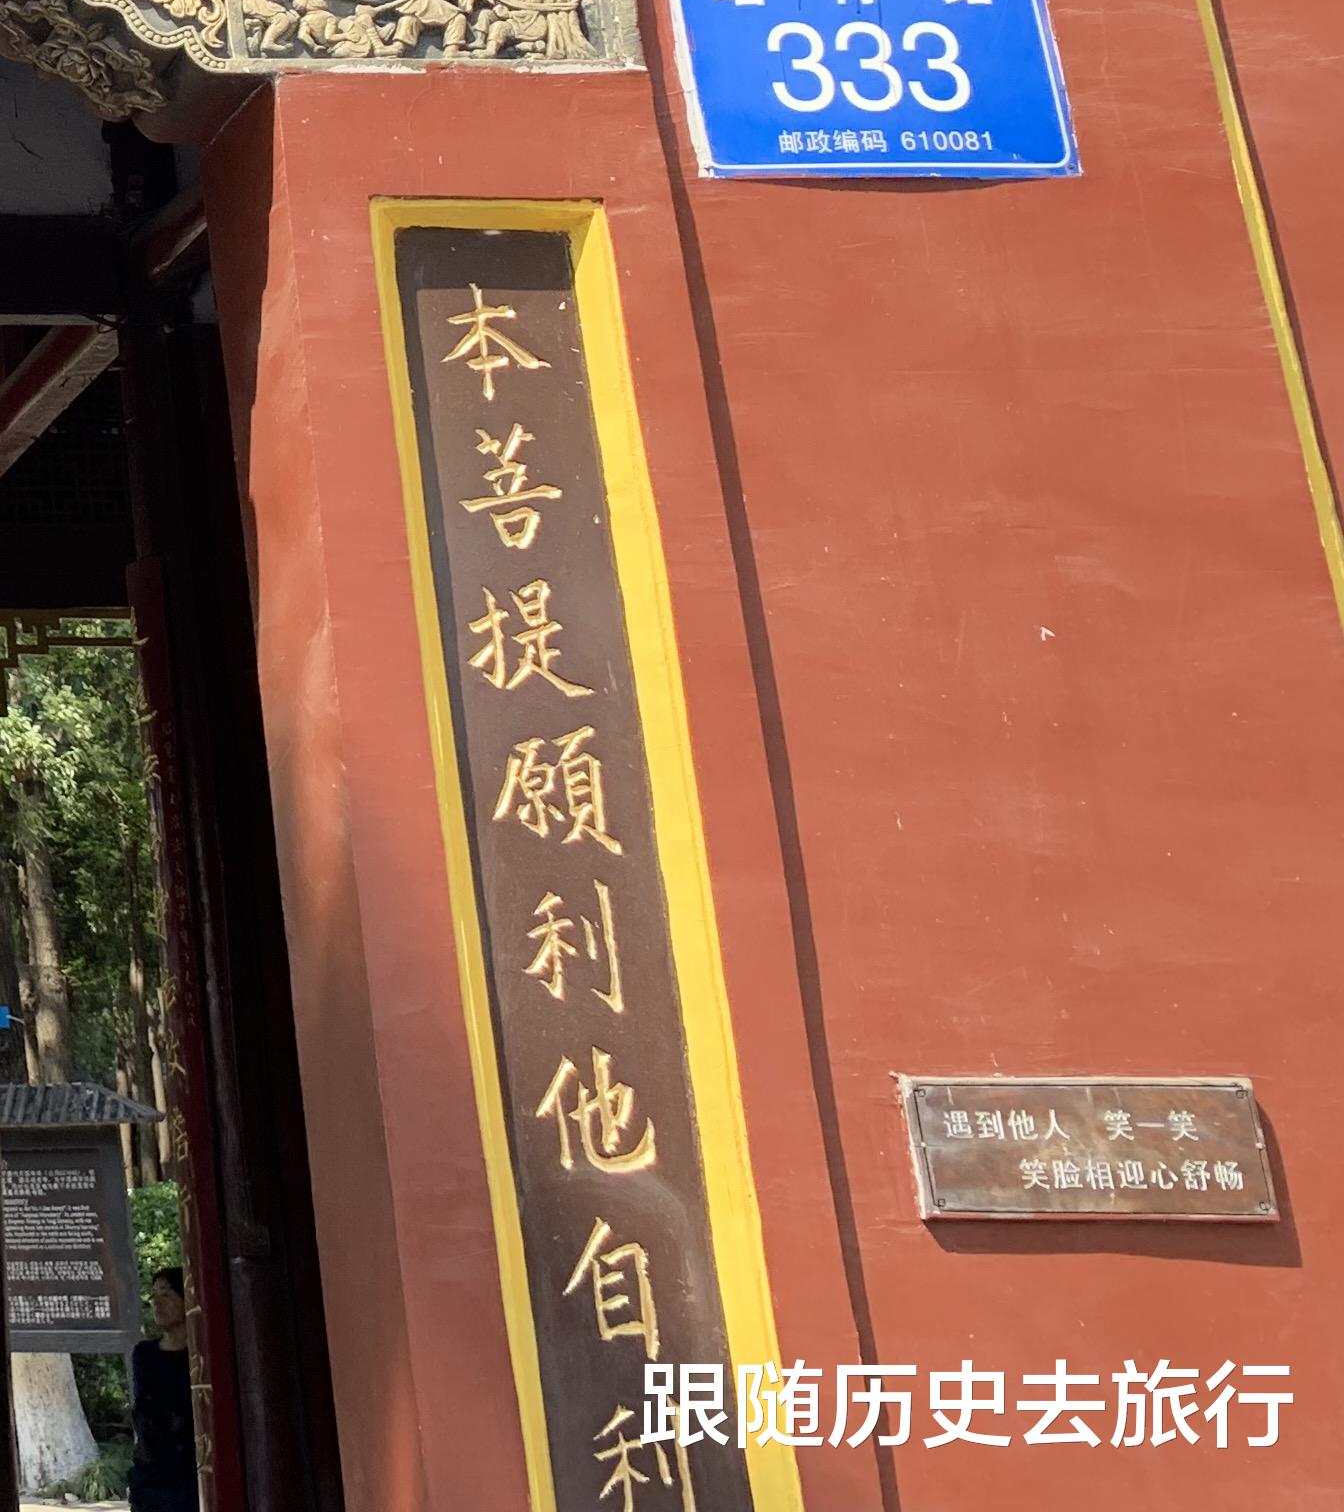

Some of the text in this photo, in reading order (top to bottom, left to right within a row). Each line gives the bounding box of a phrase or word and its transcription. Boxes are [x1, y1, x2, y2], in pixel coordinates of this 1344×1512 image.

[766, 20, 972, 113] 333
[778, 129, 994, 155] 邮政编码 610081
[943, 1108, 1200, 1142] 遇到他人 笑一笑
[1018, 1158, 1245, 1192] 笑脸相迎心舒畅
